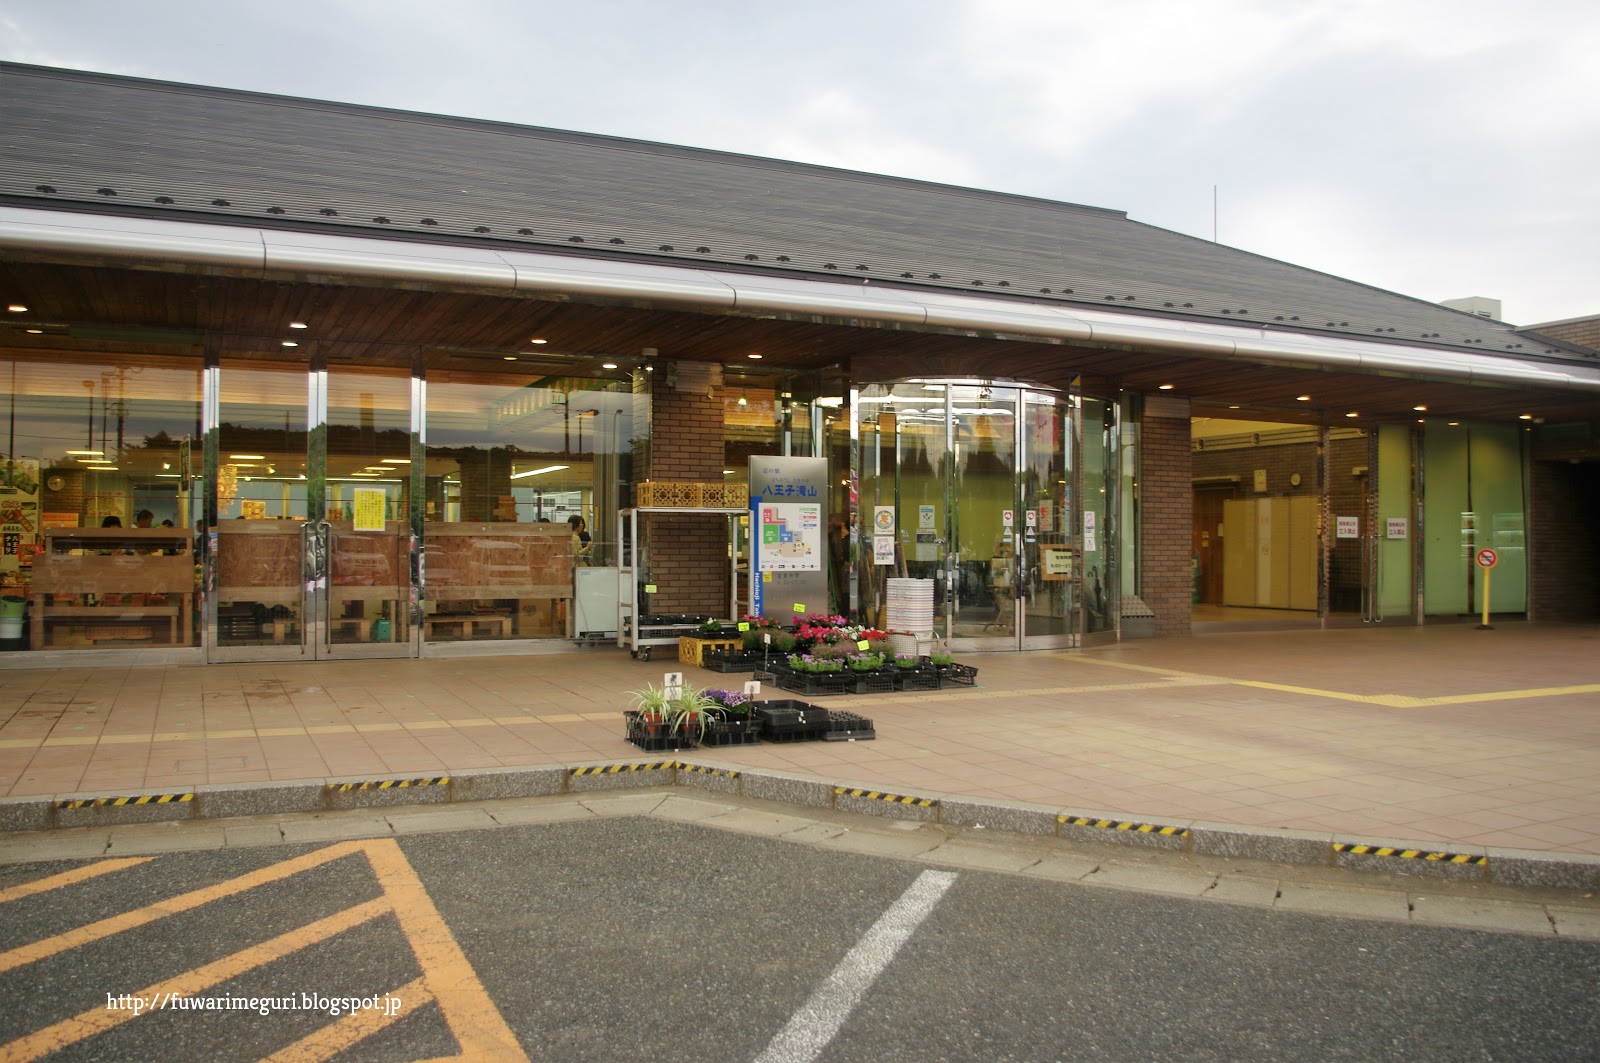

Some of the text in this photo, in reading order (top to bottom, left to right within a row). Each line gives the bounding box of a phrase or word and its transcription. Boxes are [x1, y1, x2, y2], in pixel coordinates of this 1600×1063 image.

[762, 484, 818, 497] 八王子滝山
